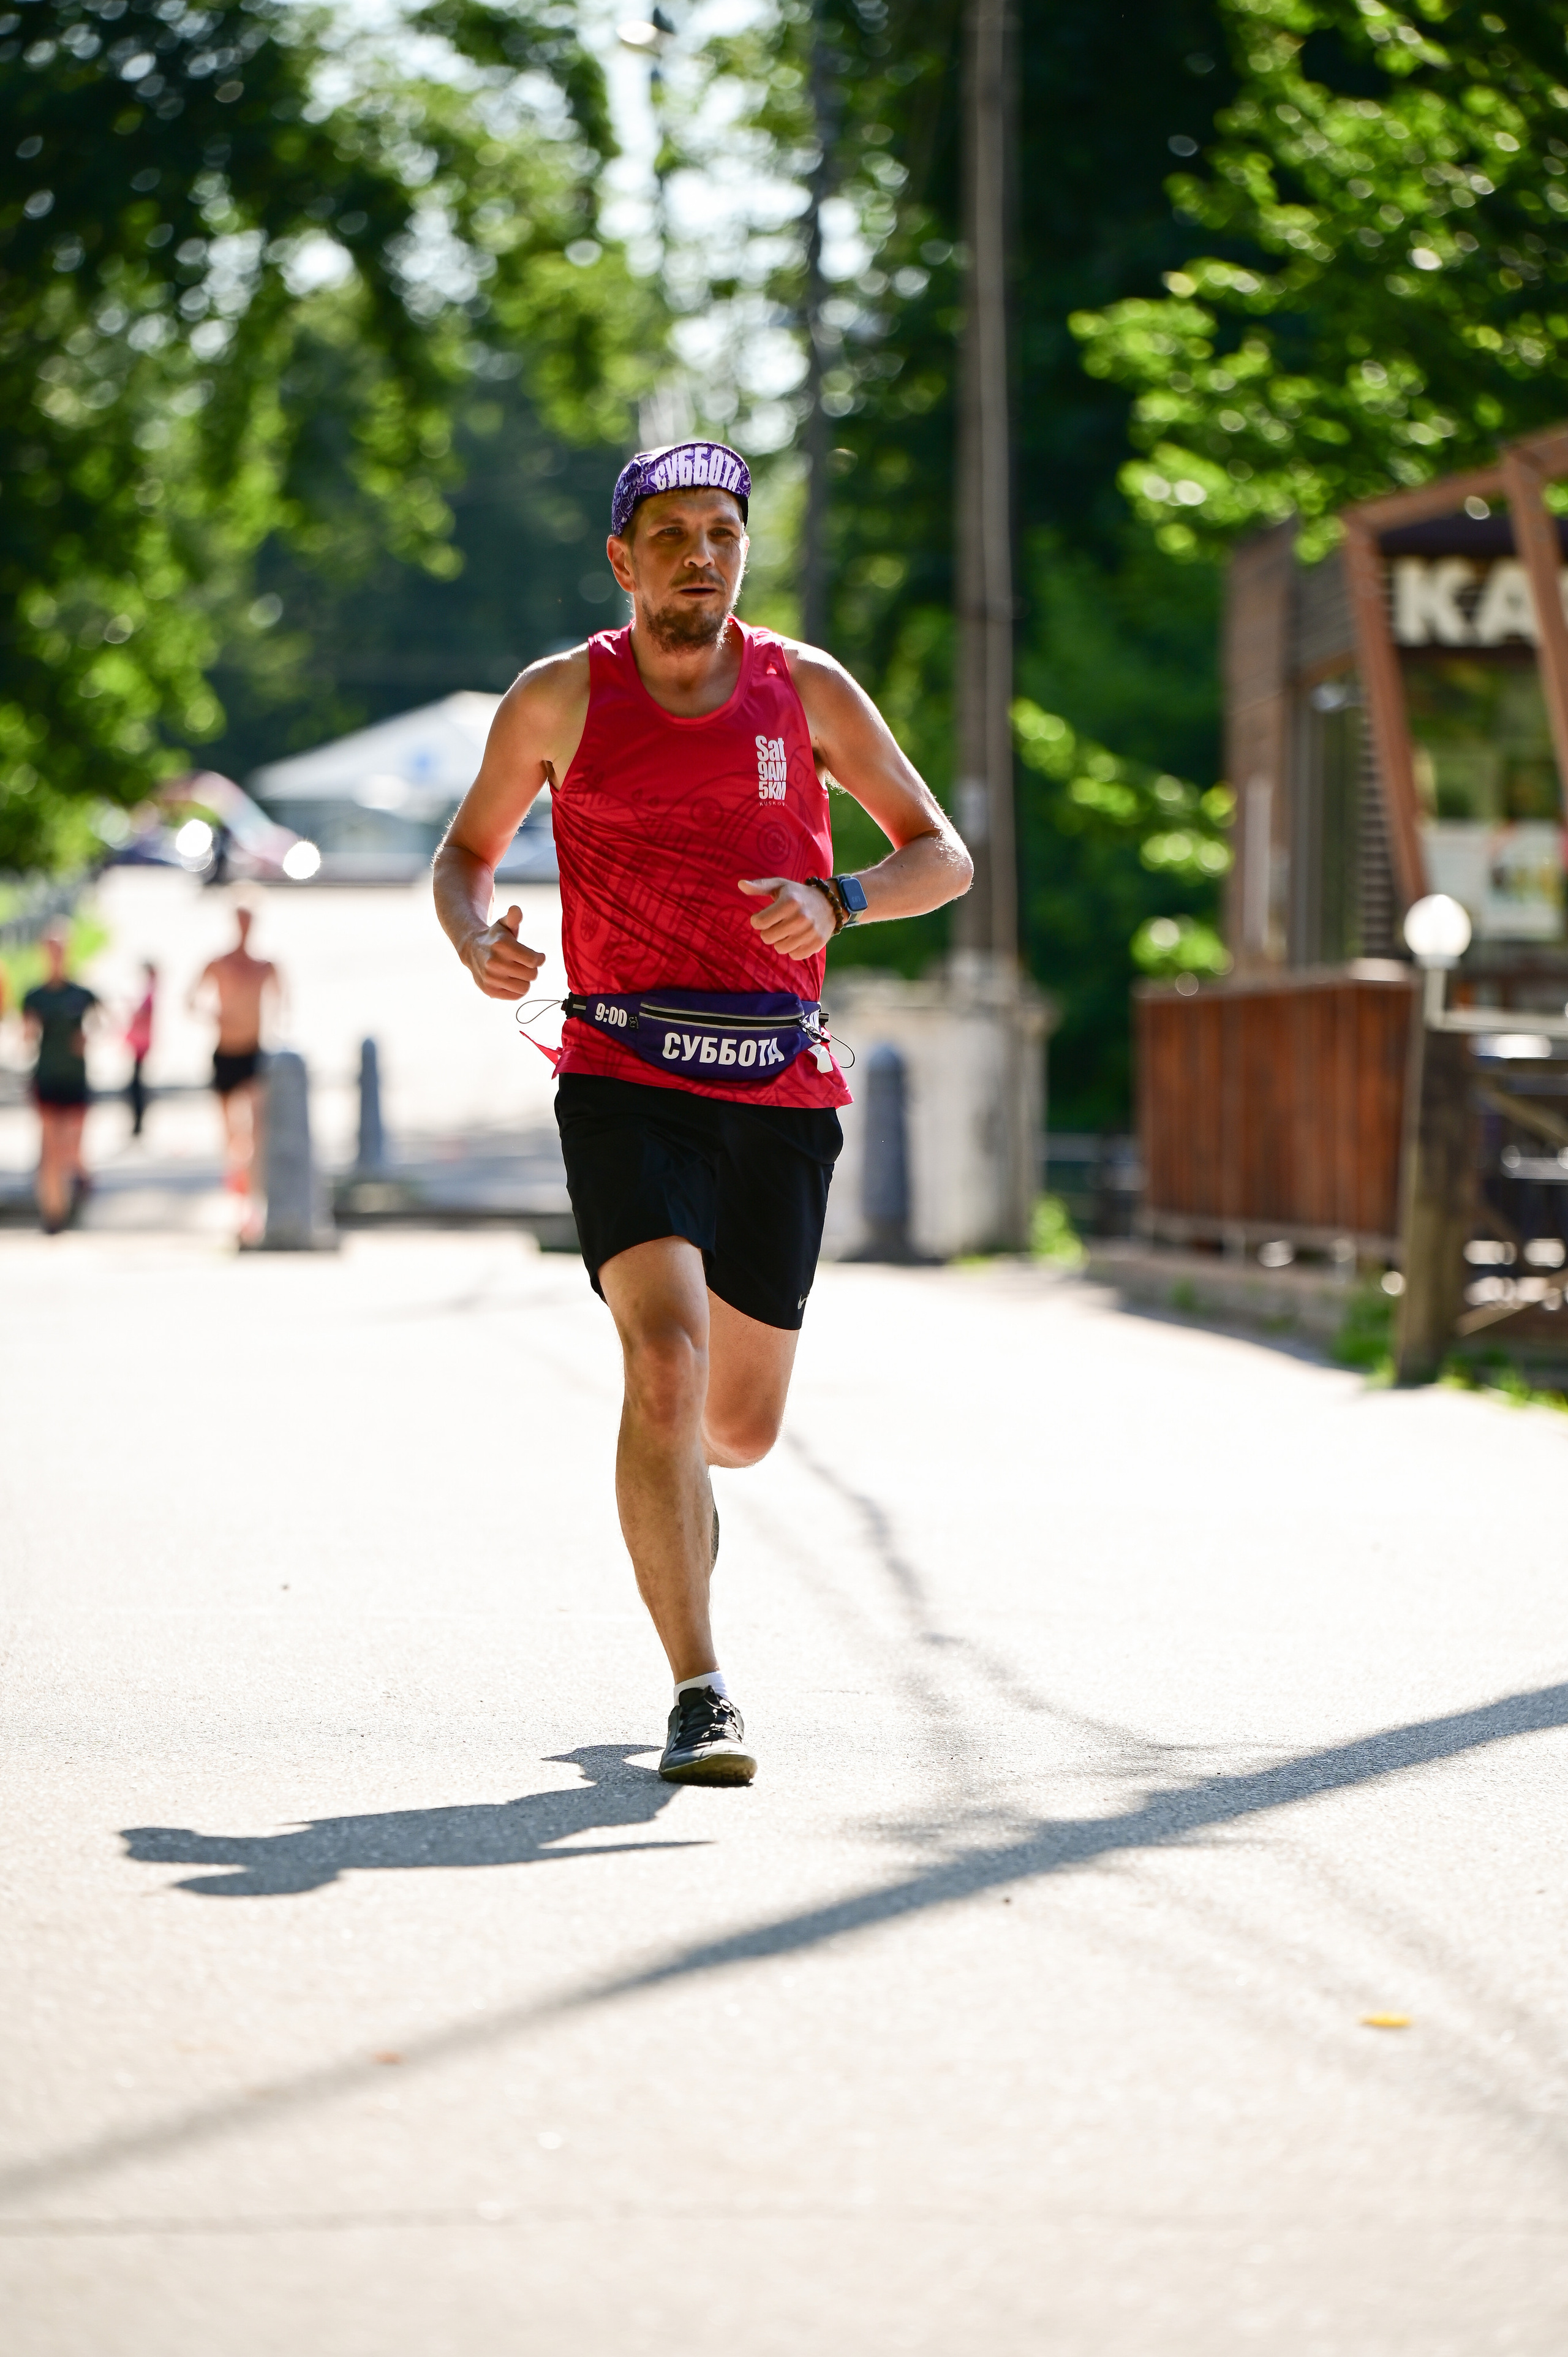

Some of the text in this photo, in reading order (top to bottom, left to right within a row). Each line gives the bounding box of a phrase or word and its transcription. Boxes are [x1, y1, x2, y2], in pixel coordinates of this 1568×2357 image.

[655, 447, 742, 491] СУББОТА
[1393, 556, 1568, 646] КА
[755, 735, 786, 762] Sat
[758, 761, 787, 781] 9AM
[758, 781, 786, 801] 5KM
[595, 1002, 628, 1027] 9:00
[662, 1032, 785, 1067] СУББОТА
